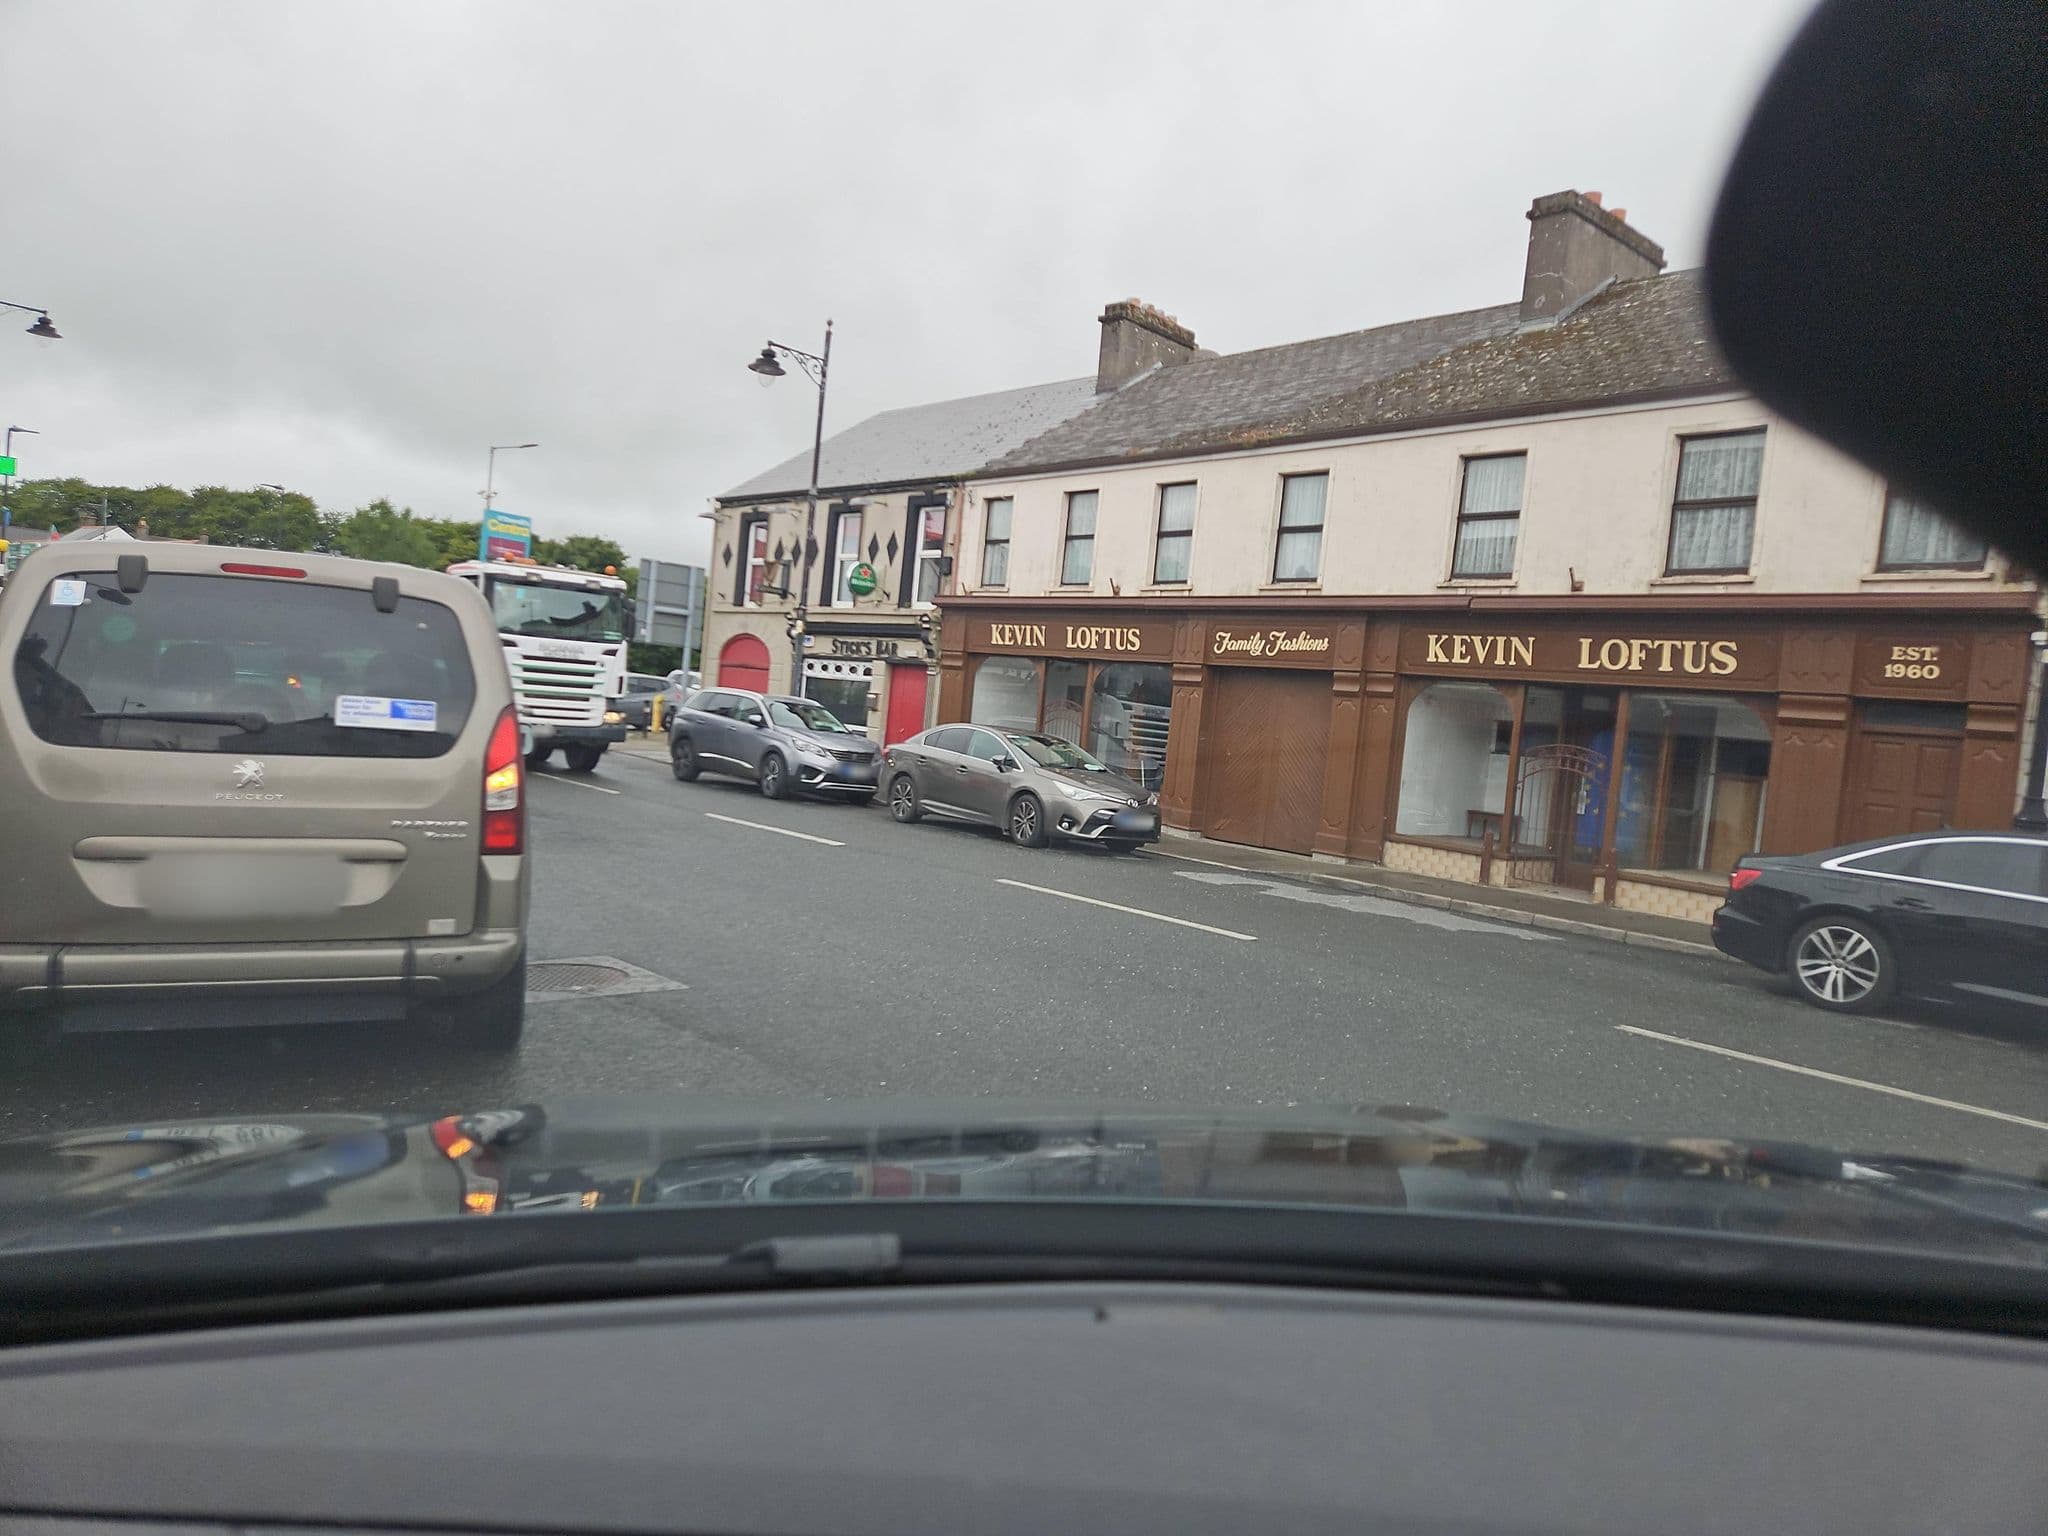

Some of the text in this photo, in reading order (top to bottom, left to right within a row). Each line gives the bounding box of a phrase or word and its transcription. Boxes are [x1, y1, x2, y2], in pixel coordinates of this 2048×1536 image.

[990, 623, 1141, 651] KEVIN LOFTUS
[1213, 630, 1329, 657] Family Fashions
[875, 639, 899, 657] BAR
[1426, 634, 1738, 675] KEVIN LOFTUS
[1890, 646, 1939, 661] EST.
[1884, 663, 1940, 679] 1960
[215, 792, 285, 801] PEUGEOT
